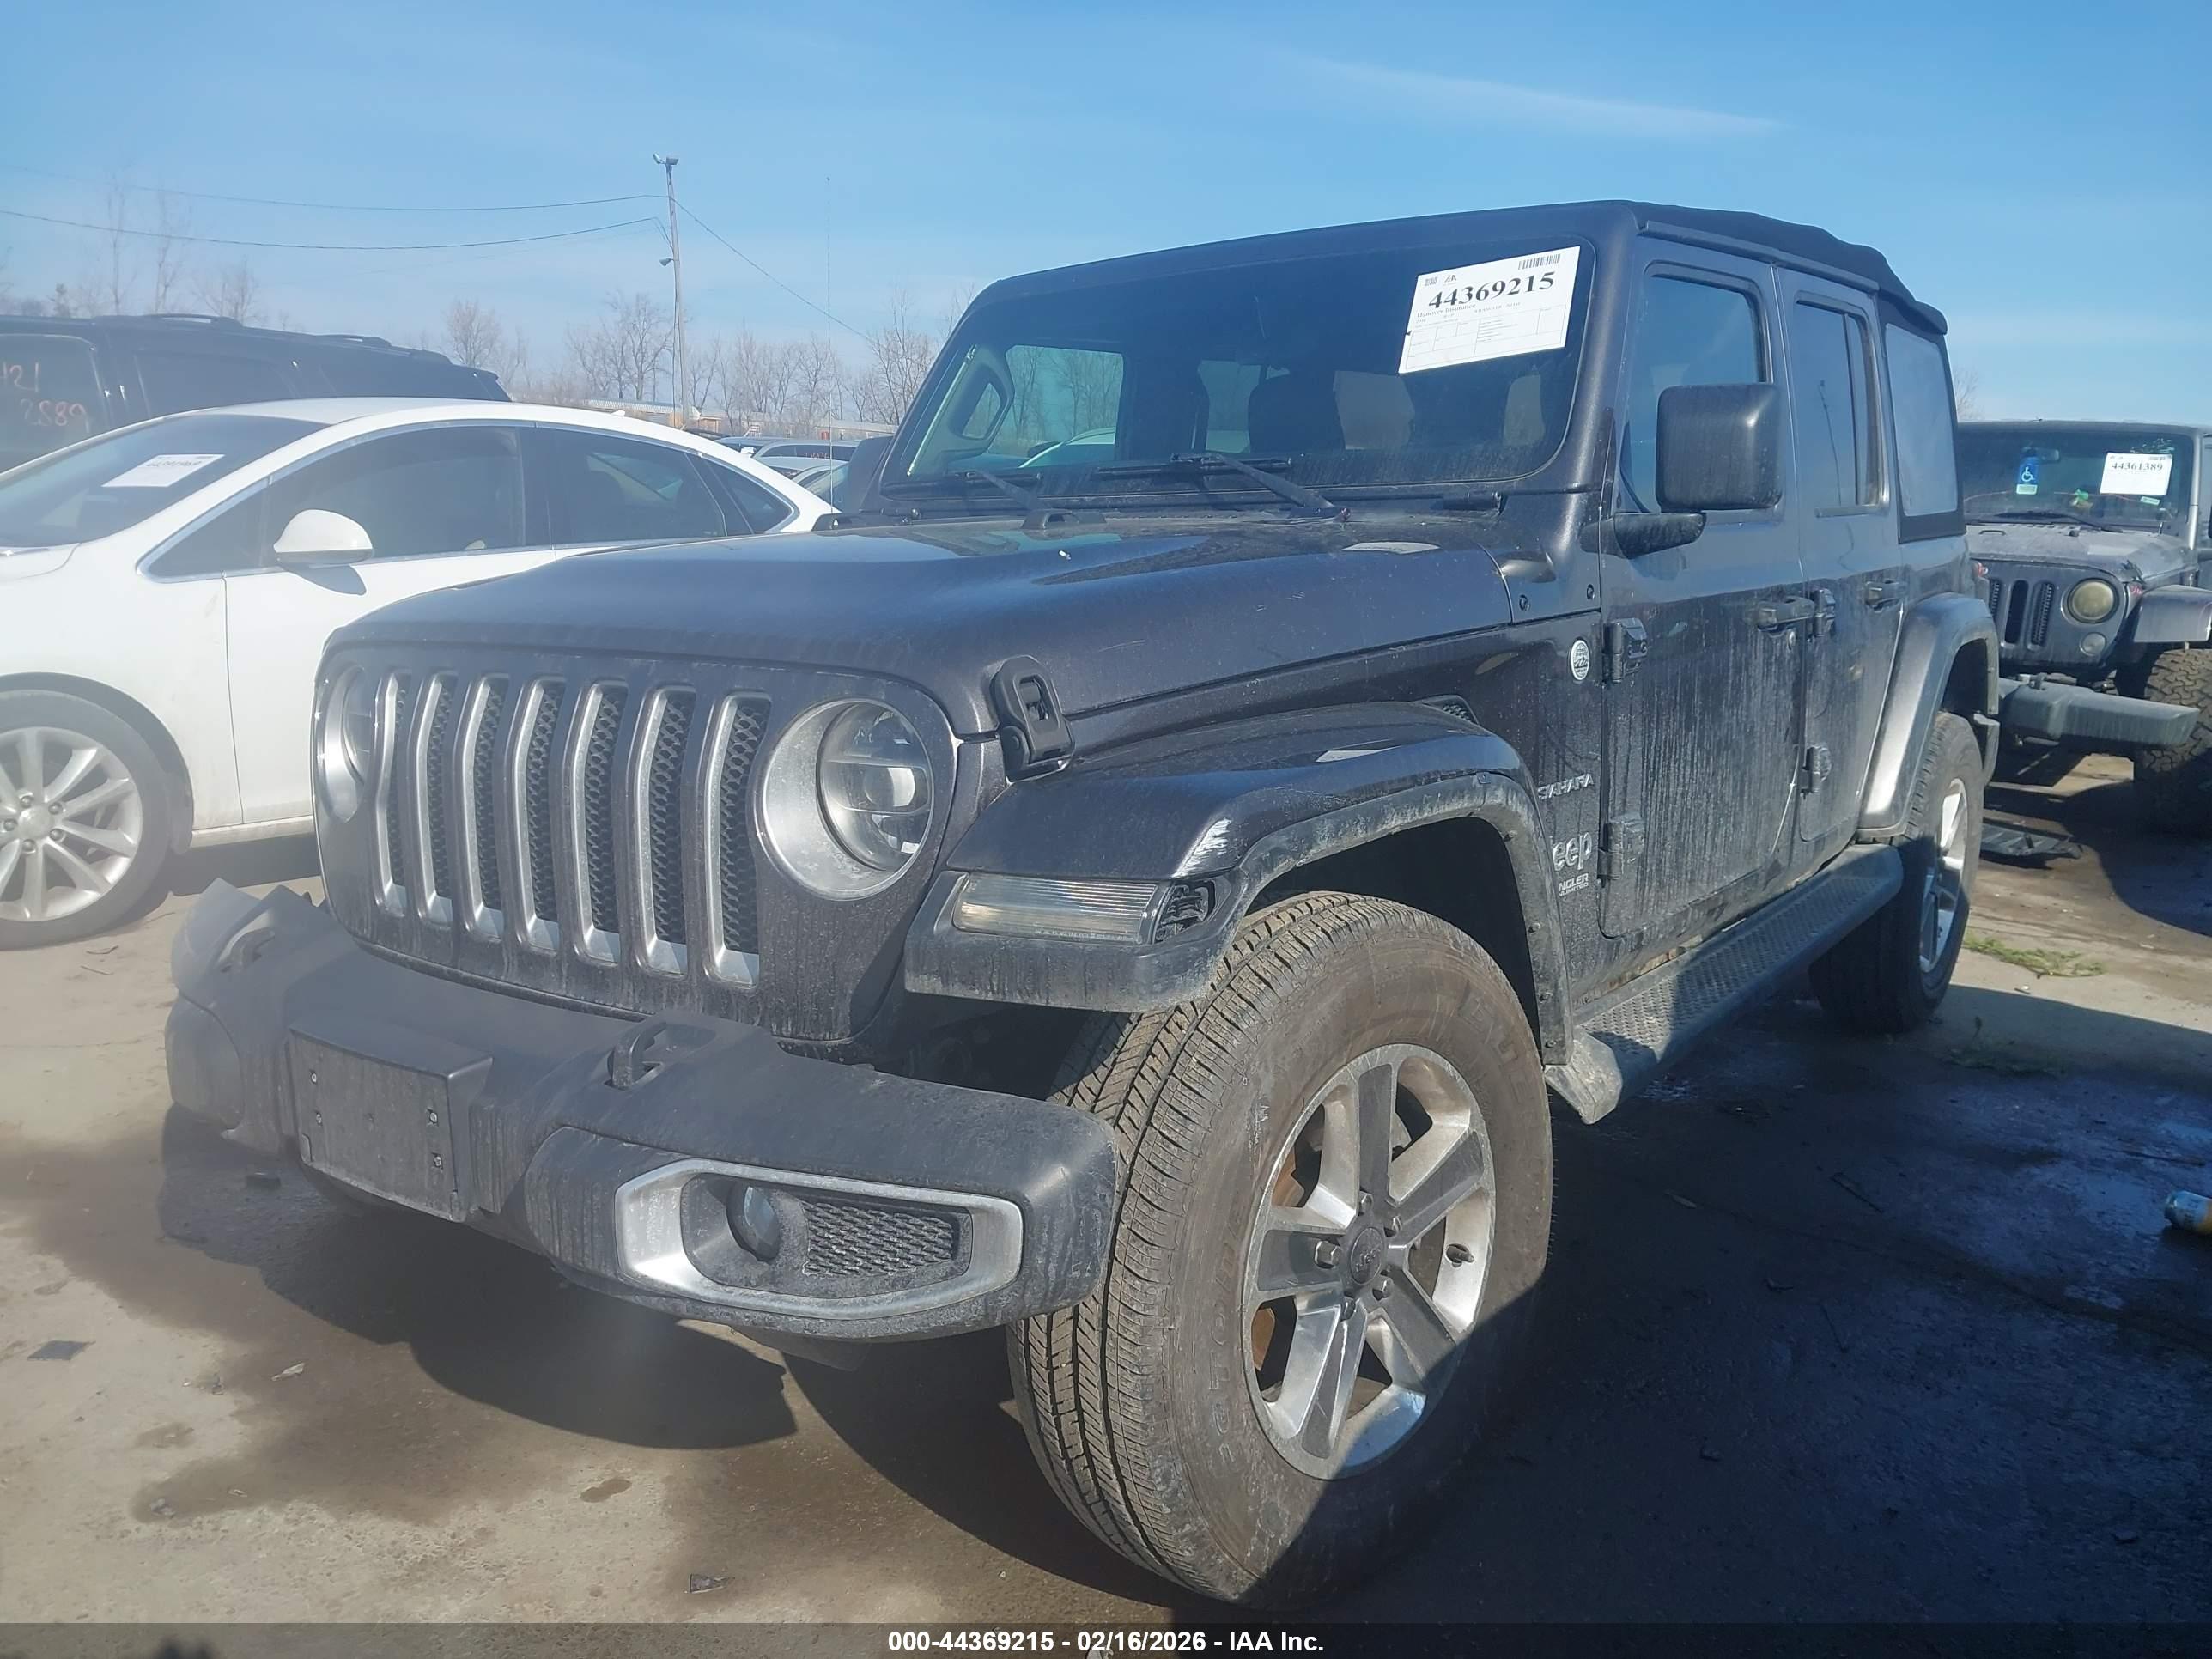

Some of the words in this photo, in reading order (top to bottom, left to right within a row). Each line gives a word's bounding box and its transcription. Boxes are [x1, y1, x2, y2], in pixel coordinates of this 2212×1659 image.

[1428, 270, 1556, 308] 44369215
[2112, 461, 2163, 471] 44361389
[1537, 774, 1595, 799] SAHARA
[1550, 830, 1593, 872] eep
[1558, 872, 1589, 891] NGLER
